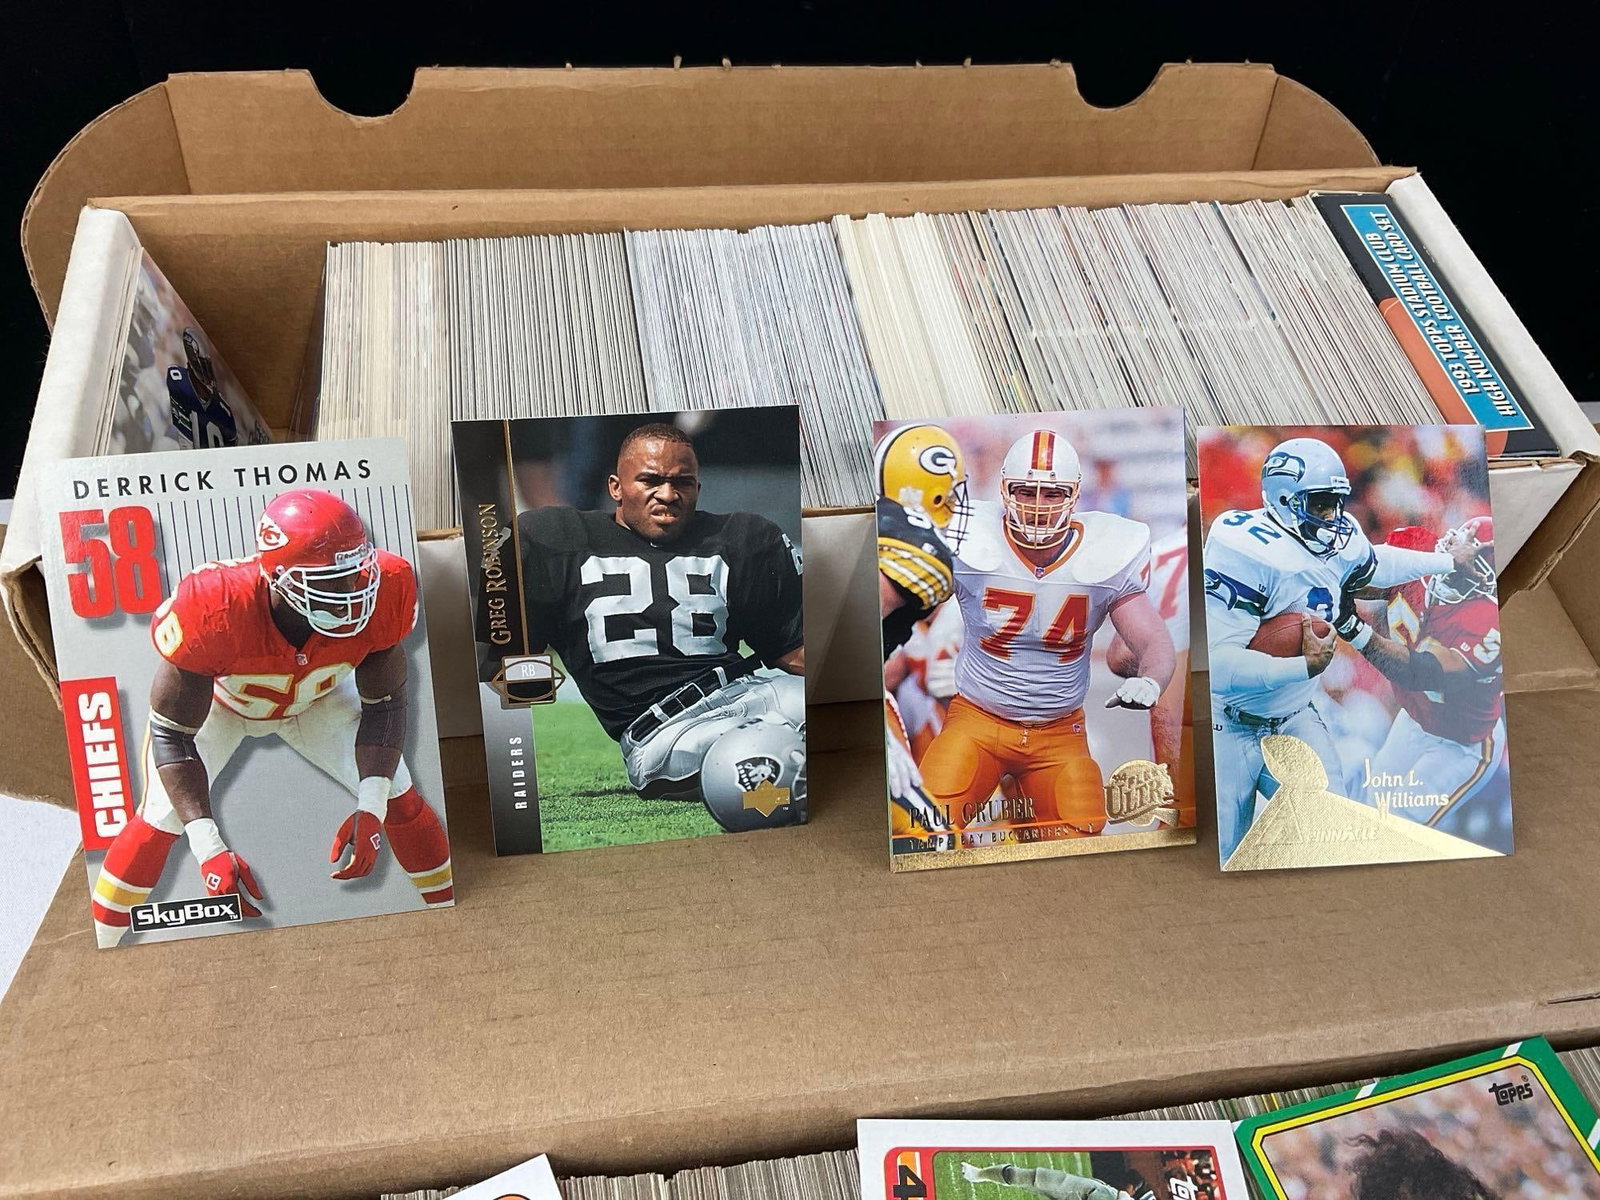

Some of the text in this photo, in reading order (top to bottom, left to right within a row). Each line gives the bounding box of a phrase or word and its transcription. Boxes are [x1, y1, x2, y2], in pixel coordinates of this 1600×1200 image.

[1365, 232, 1481, 394] 1993 TOPPS STADIUM CLUB
[1369, 211, 1517, 416] HIGH NUMBER FOOTBALL CARD SET
[73, 459, 371, 500] DERRICK THOMAS
[59, 505, 162, 619] 58
[478, 503, 511, 646] GREG ROBINSON
[580, 555, 730, 664] 28
[979, 587, 1090, 664] 74
[521, 664, 536, 678] RB
[78, 691, 128, 838] CHIEFS
[509, 736, 528, 810] RAIDERS
[1362, 758, 1424, 788] John L.
[909, 797, 1036, 829] PAUL GRUBER
[1374, 791, 1450, 818] Williams
[909, 836, 953, 850] TAMPA
[136, 903, 235, 926] SkyBox
